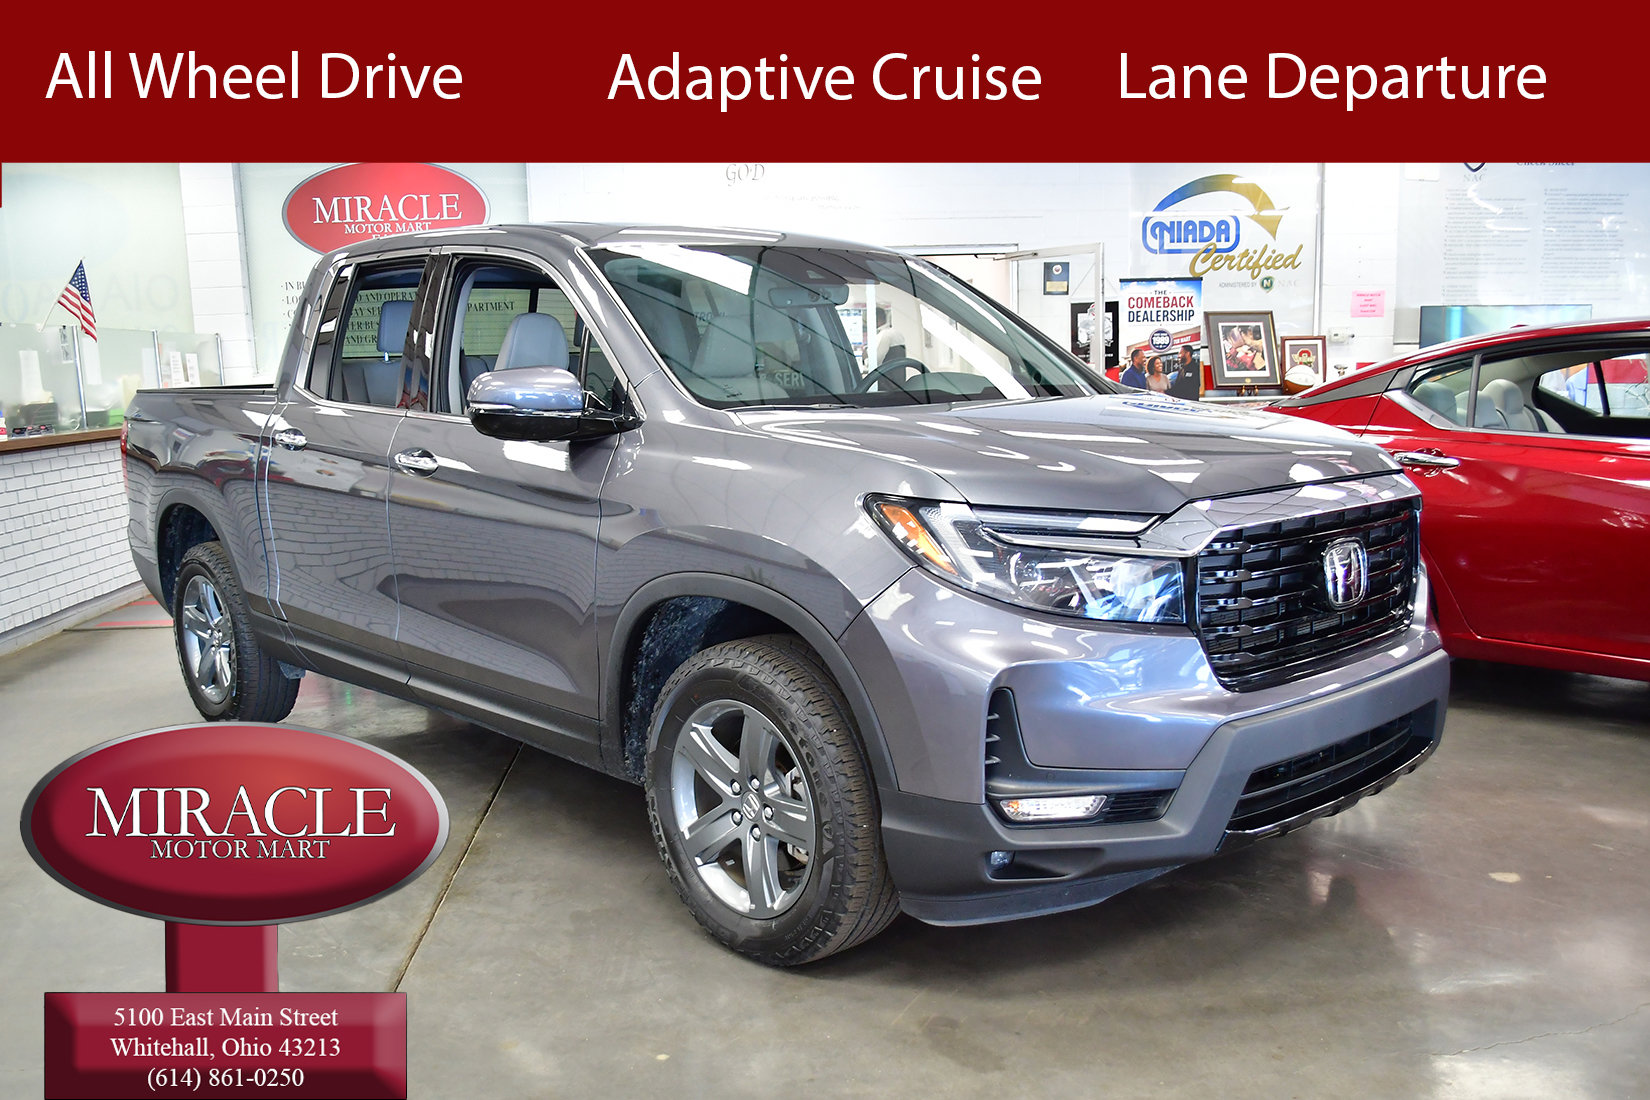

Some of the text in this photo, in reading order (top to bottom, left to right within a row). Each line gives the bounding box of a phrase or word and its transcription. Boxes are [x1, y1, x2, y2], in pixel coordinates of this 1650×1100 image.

[312, 194, 463, 223] MIRACLE
[344, 222, 432, 234] MOTOR MART
[1150, 219, 1230, 254] NIADA
[1189, 242, 1304, 280] Certified
[467, 301, 515, 312] PARTMENT
[1127, 296, 1194, 309] COMEBACK
[1127, 309, 1195, 323] DEALERSHIP
